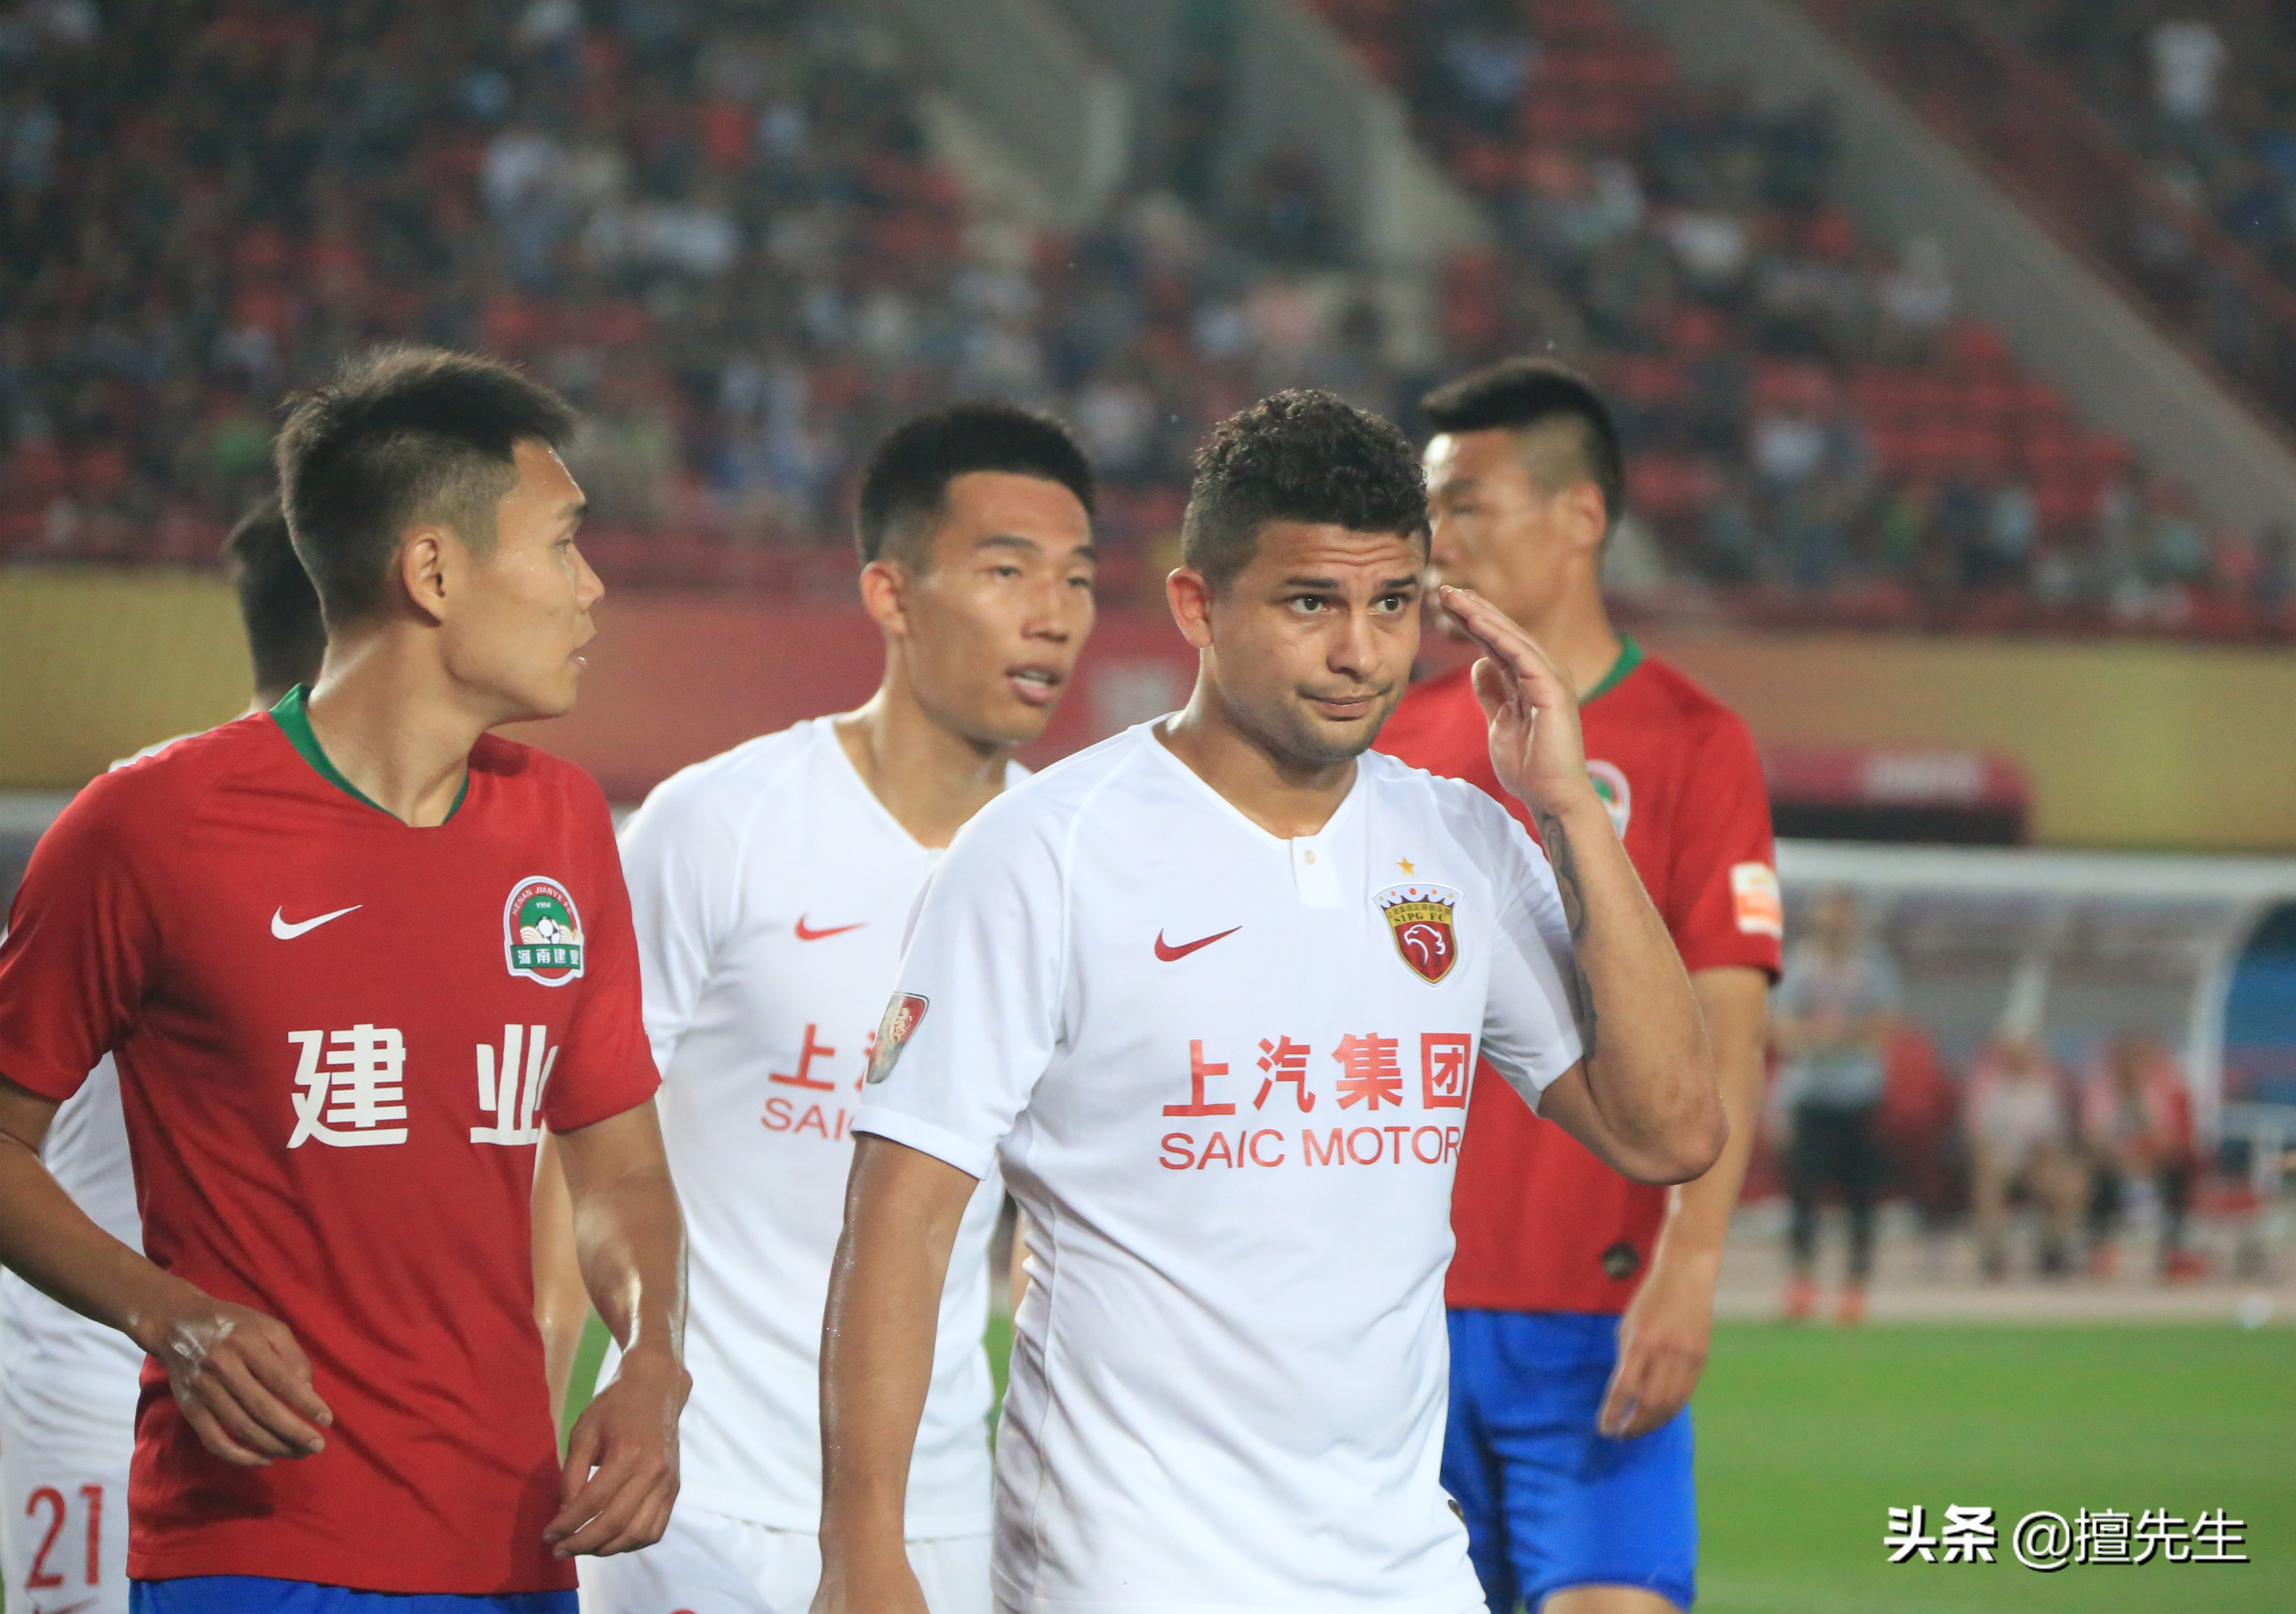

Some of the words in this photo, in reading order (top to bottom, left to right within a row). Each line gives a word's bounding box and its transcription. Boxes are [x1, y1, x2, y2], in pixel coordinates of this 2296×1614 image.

[512, 888, 533, 916] HENAN
[1394, 911, 1424, 924] SIPG
[1430, 912, 1446, 922] FC
[285, 1023, 559, 1149] 建业
[769, 1021, 876, 1093] 上
[1162, 1032, 1471, 1117] 上汽集团
[761, 1096, 854, 1142] SAI
[1159, 1128, 1285, 1170] SAIC
[1303, 1126, 1461, 1166] MOTOR
[25, 1485, 103, 1591] 21
